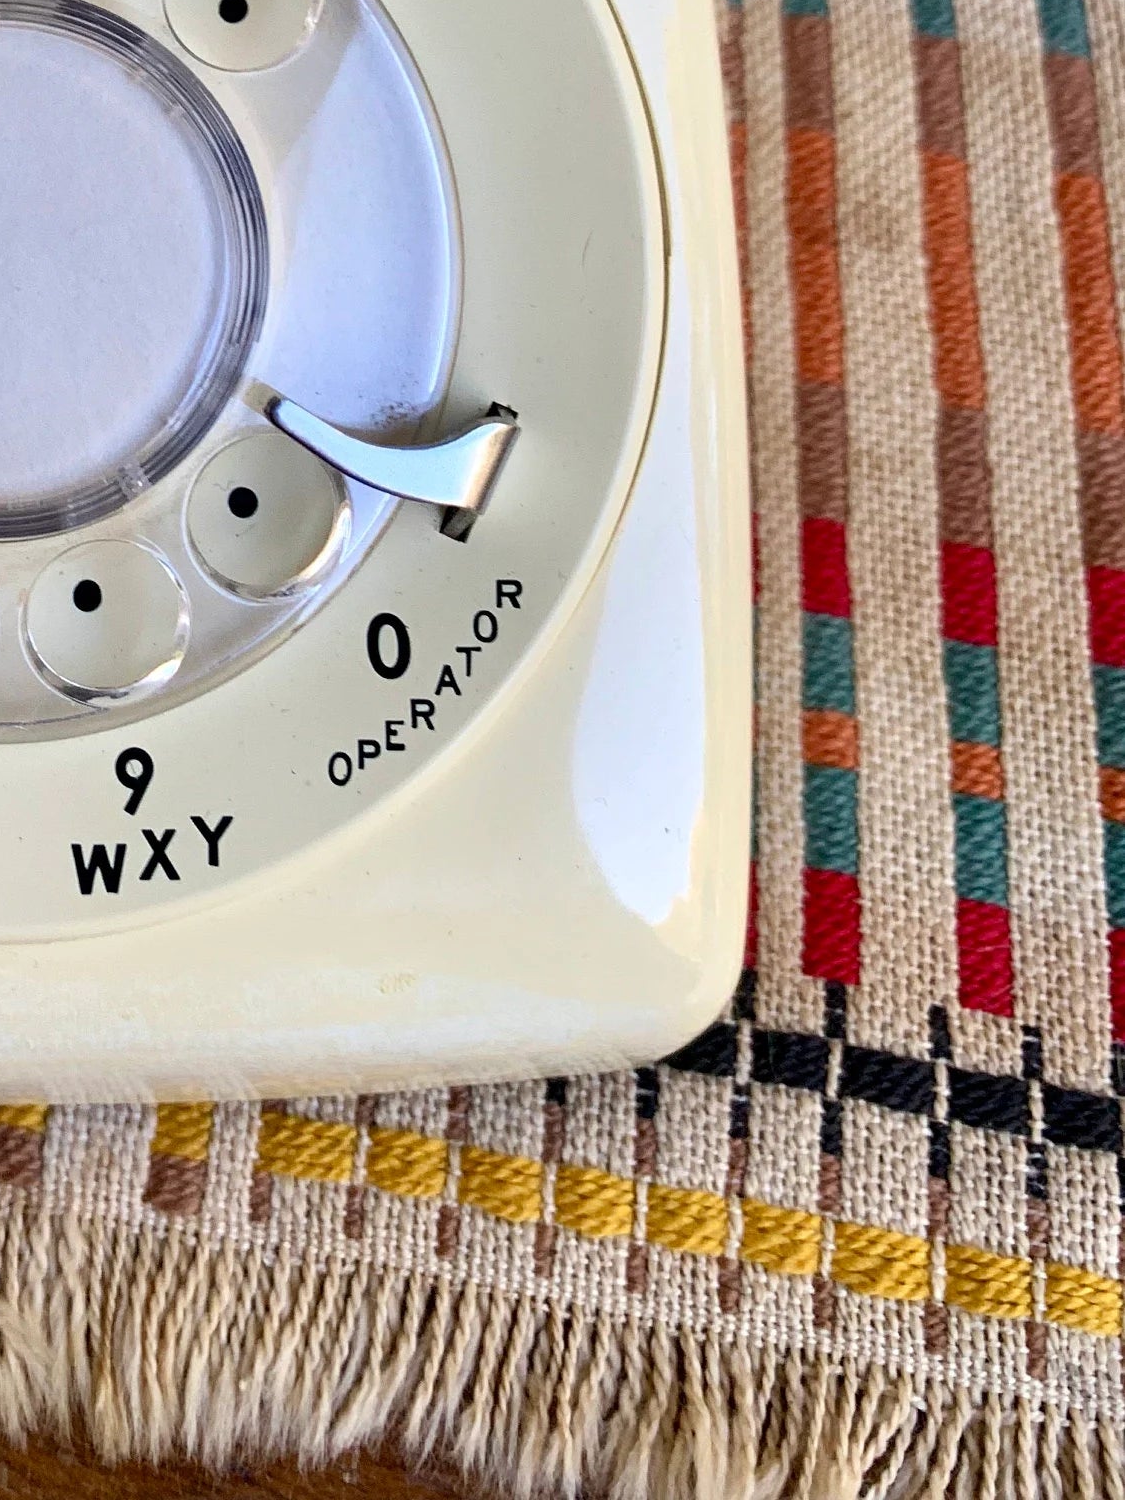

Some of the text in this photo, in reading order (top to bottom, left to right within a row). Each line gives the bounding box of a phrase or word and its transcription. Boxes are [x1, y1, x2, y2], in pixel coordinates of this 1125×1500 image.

[328, 579, 523, 787] OPERATOR
[366, 612, 412, 680] 0
[115, 746, 154, 816] 9
[71, 815, 234, 896] WXY
